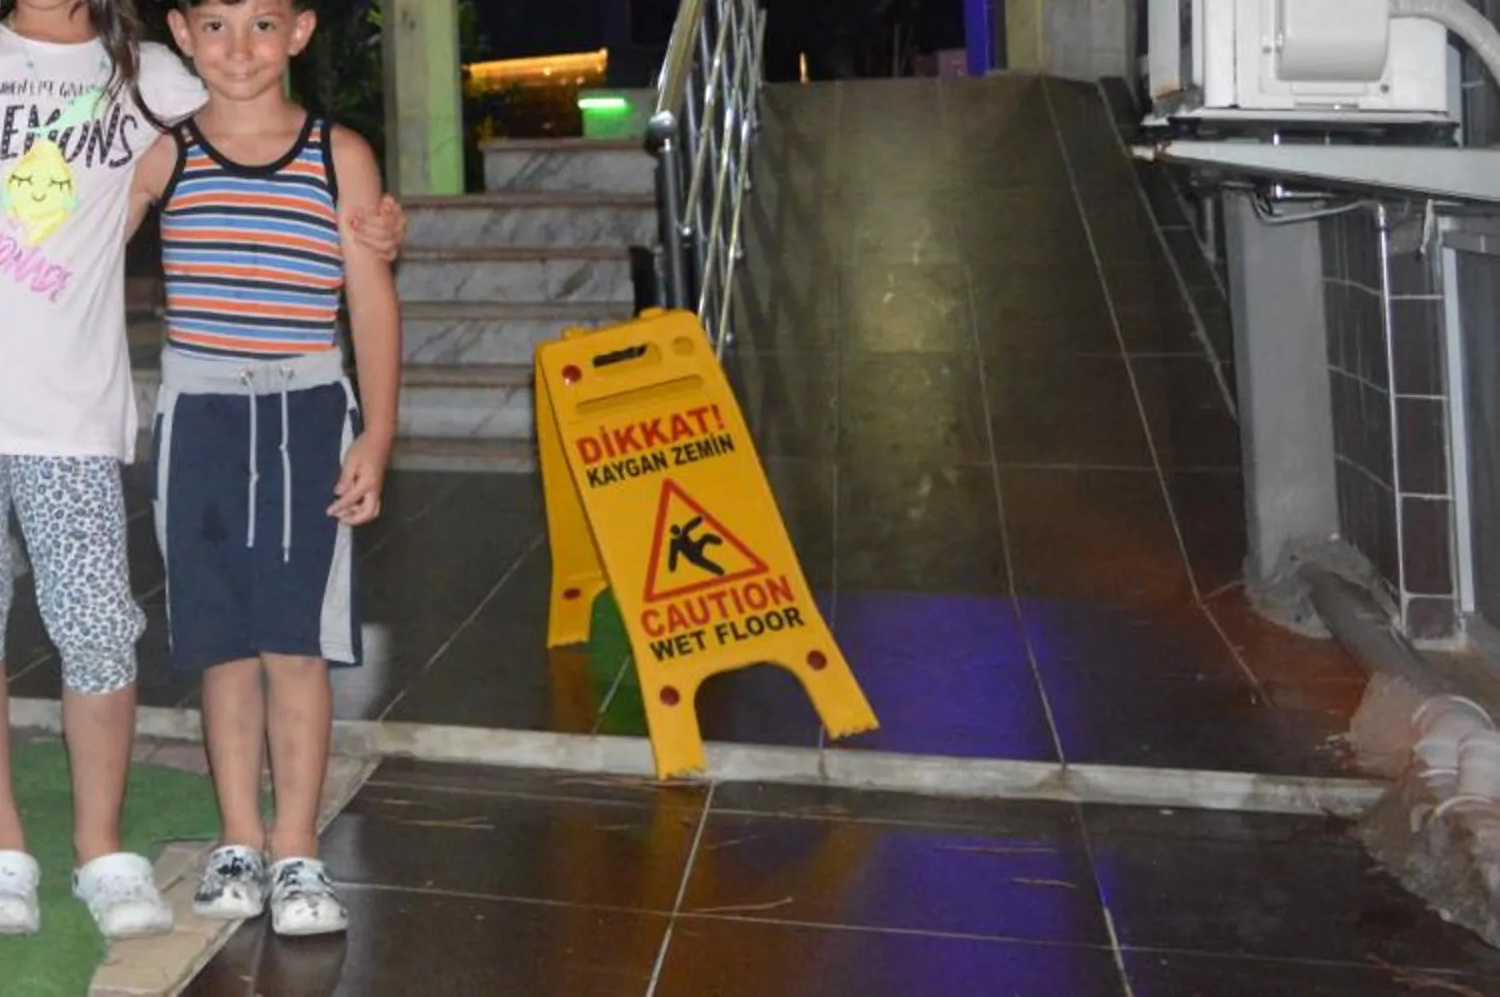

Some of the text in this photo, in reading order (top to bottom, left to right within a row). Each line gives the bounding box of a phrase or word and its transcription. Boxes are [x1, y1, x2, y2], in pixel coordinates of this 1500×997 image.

[575, 404, 725, 465] DİKKAT!
[586, 432, 735, 489] KAYGAN ZEMİN
[640, 575, 795, 638] CAUTION
[650, 606, 805, 662] WET FLOOR
